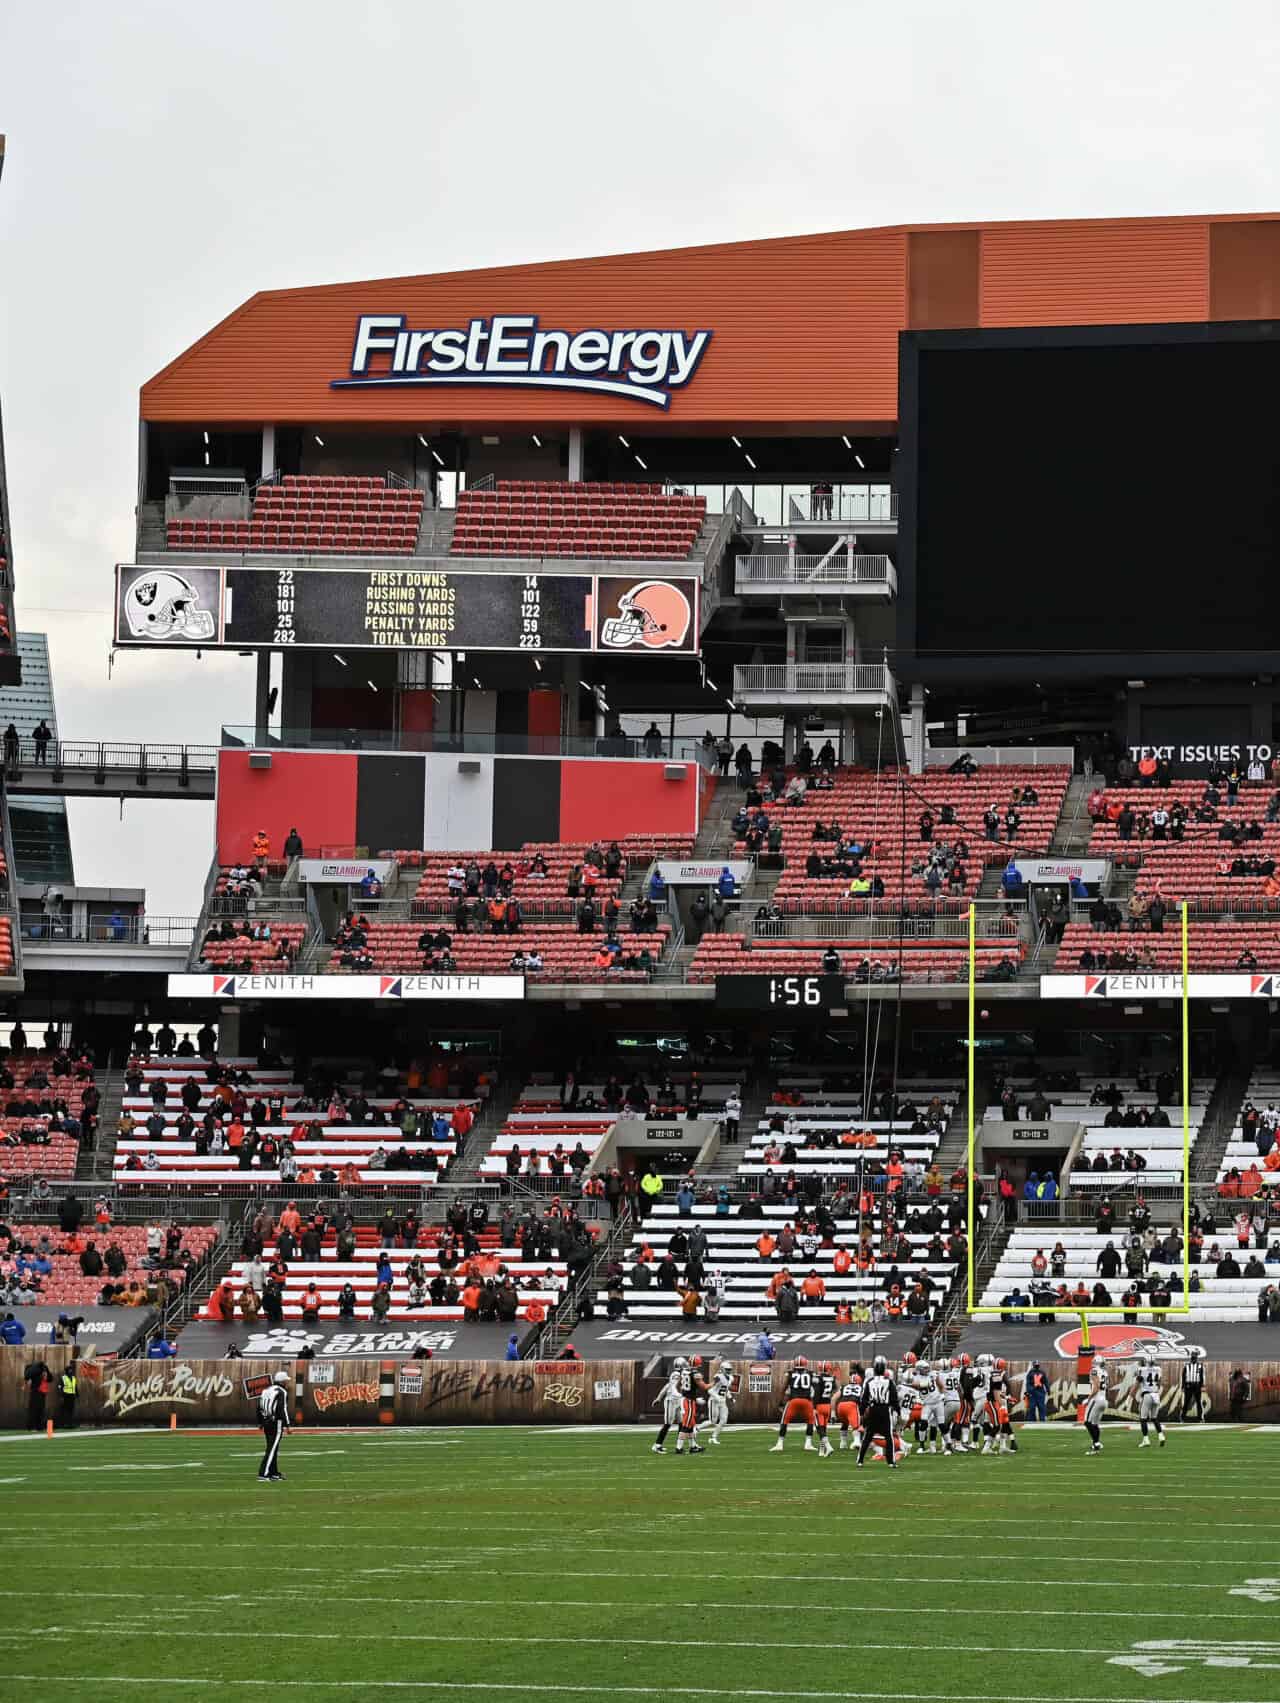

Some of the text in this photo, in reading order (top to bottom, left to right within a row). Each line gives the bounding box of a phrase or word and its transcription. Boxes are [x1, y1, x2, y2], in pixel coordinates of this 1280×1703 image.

[350, 313, 712, 388] FirstEnergy
[279, 571, 294, 584] 22
[370, 572, 447, 587] FIRST DOWNS
[525, 576, 538, 589] 14
[277, 585, 295, 598] 181
[366, 588, 455, 601] RUSHING YARDS
[523, 589, 540, 603] 101
[277, 599, 294, 613] 101
[366, 602, 455, 616] PASSING YARDS
[520, 604, 540, 618] 122
[277, 614, 293, 628] 25
[364, 616, 455, 631] PENALTY YARDS
[523, 619, 538, 633] 59
[273, 630, 296, 643] 282
[372, 631, 447, 646] TOTAL YARDS
[519, 634, 541, 648] 223
[1129, 746, 1175, 761] TEXT
[1180, 745, 1240, 762] ISSUES
[1246, 745, 1271, 761] TO
[237, 976, 314, 990] ZENITH
[404, 977, 481, 991] ZENITH
[1109, 975, 1185, 990] ZENITH
[770, 978, 821, 1005] 1:56
[331, 1332, 430, 1343] STAY
[596, 1329, 892, 1343] BRIDGESTONE
[103, 1371, 163, 1408] DAWG
[168, 1364, 234, 1397] POUND
[427, 1369, 535, 1401] THE LAND
[791, 1373, 811, 1389] 70
[313, 1380, 381, 1412] BROWNS
